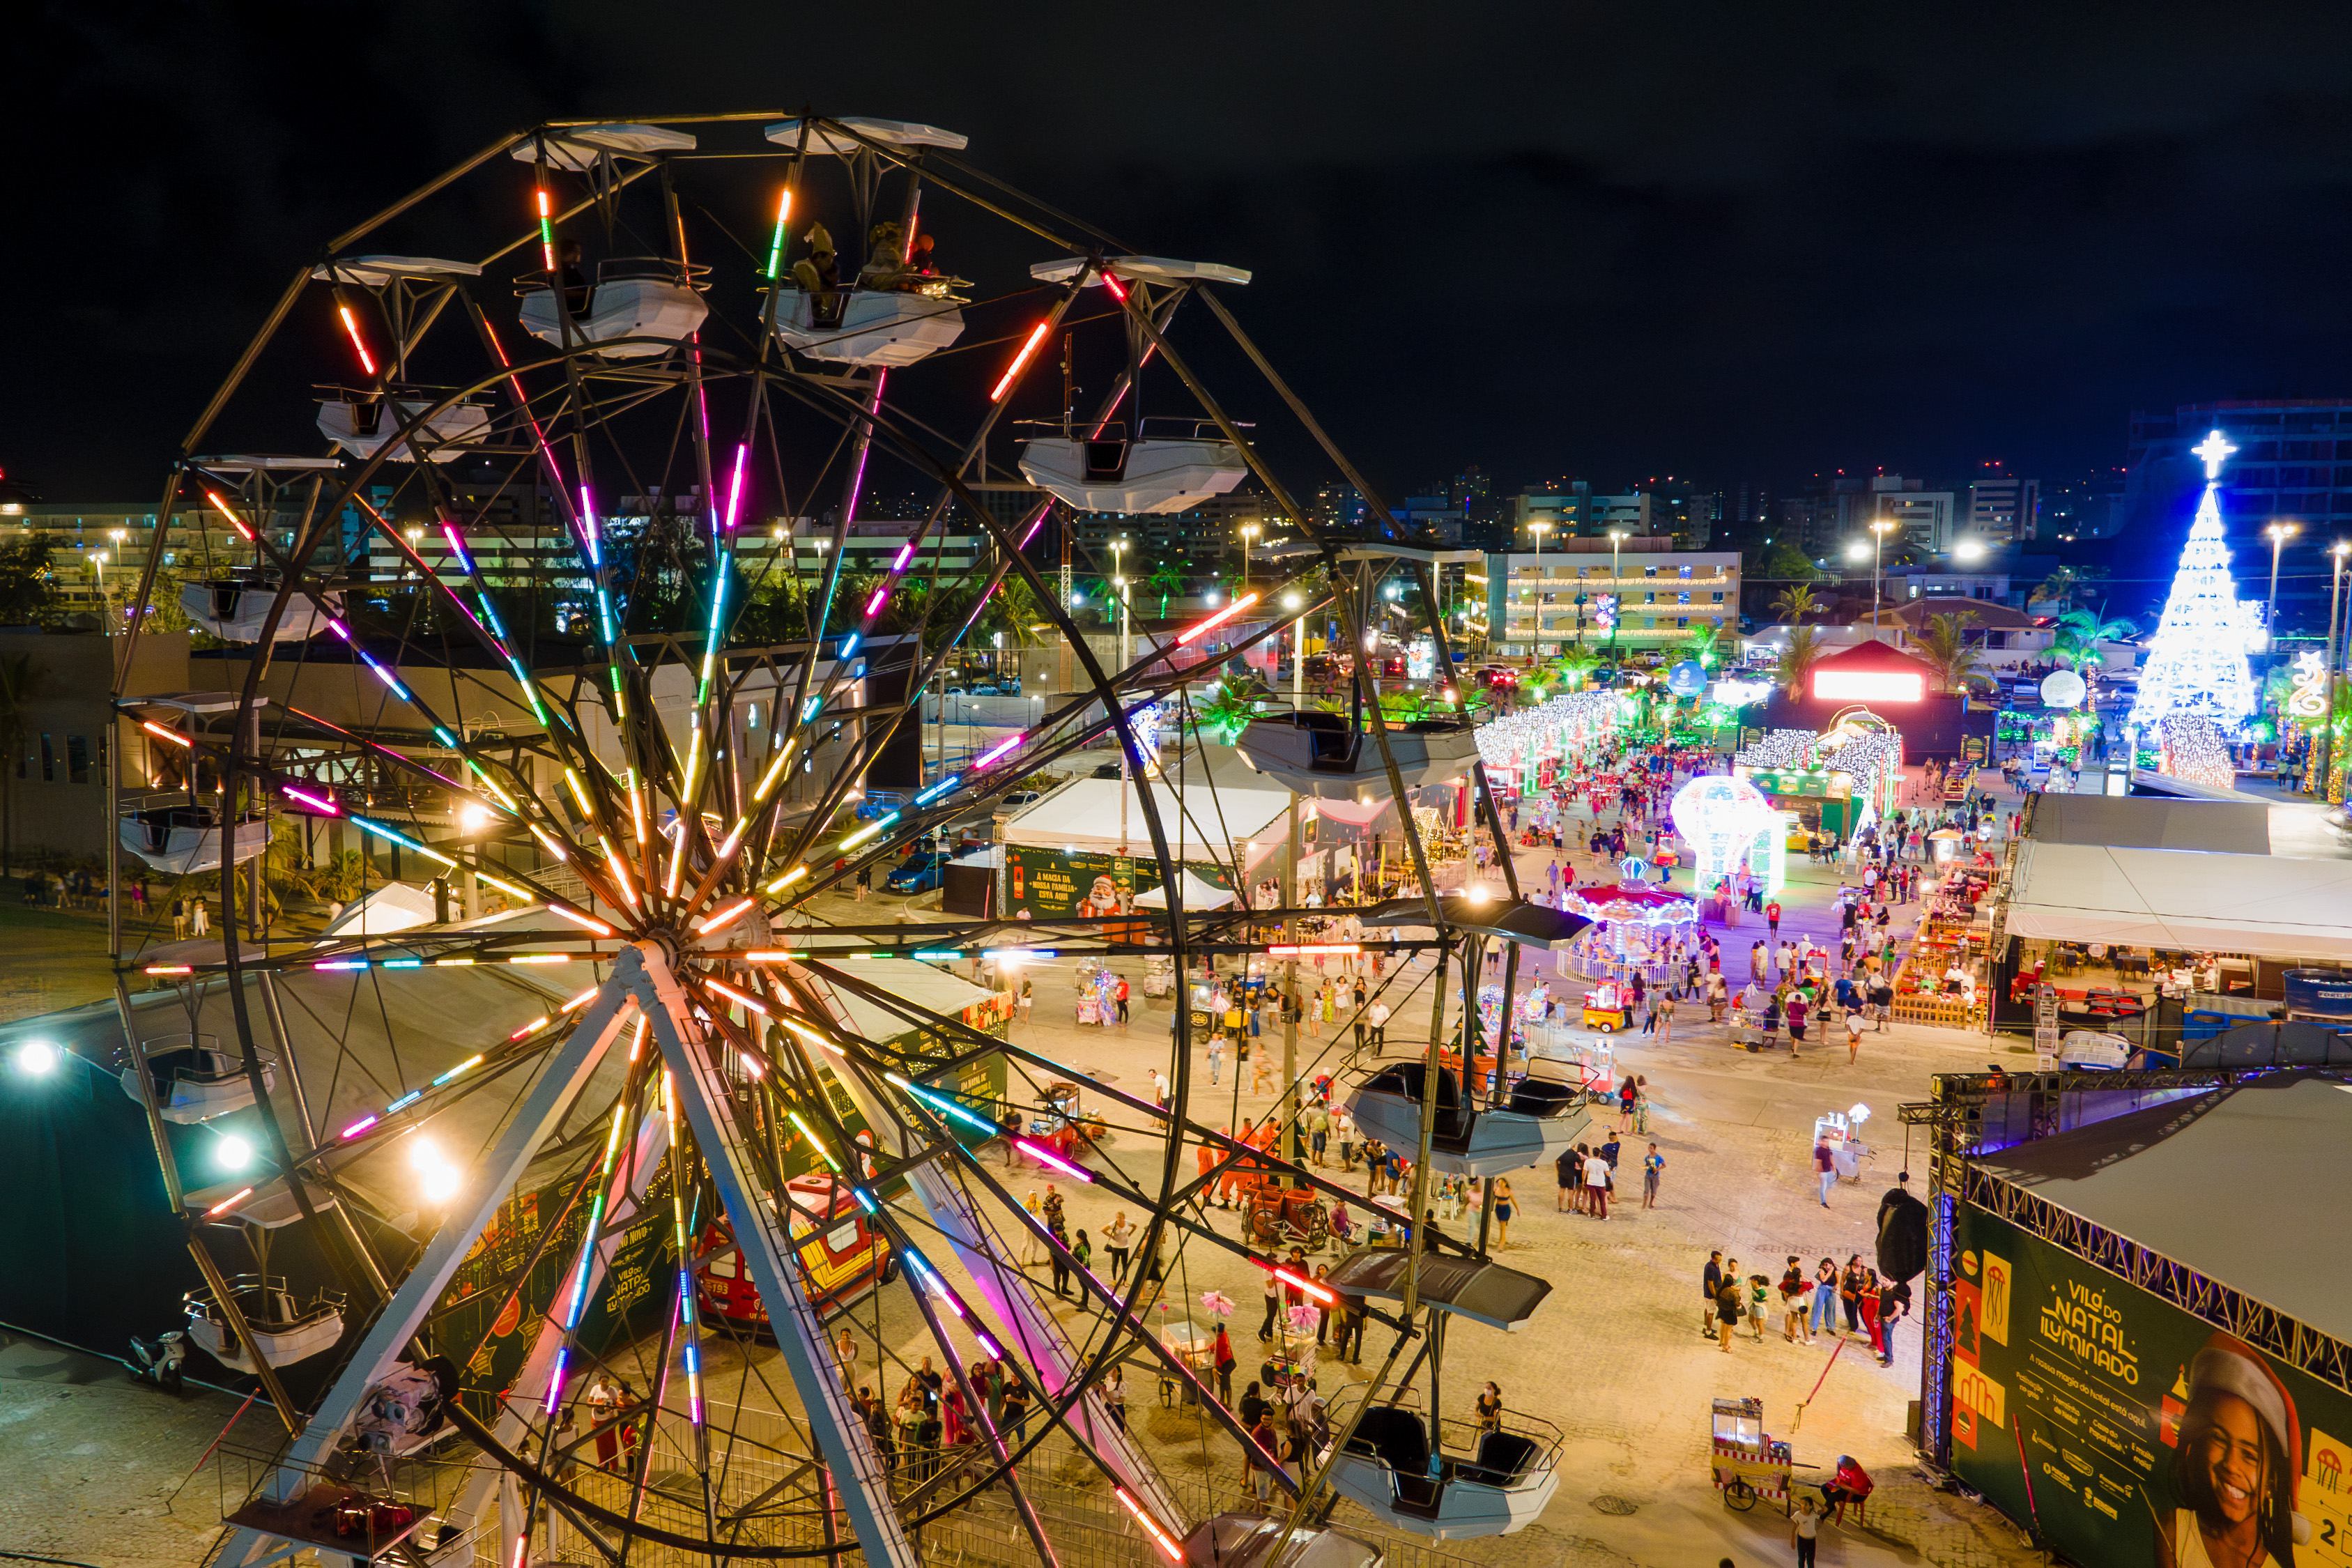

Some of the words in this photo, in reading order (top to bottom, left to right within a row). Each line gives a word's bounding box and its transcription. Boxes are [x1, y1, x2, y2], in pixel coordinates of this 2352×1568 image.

[1033, 881, 1050, 890] NOSSA
[1036, 872, 1041, 881] A
[1043, 873, 1061, 882] MAGIA
[1062, 875, 1070, 884] DA
[629, 1226, 648, 1245] NOVO
[633, 1266, 642, 1275] DO
[712, 1284, 729, 1295] 193
[2103, 1305, 2121, 1323] DO
[2042, 1296, 2137, 1363] NATAL
[2040, 1315, 2139, 1385] ILUMINADO
[2029, 1353, 2035, 1362] A
[2036, 1358, 2056, 1374] nossa
[2056, 1369, 2079, 1388] magia
[2080, 1383, 2089, 1394] do
[2090, 1388, 2110, 1407] Natal
[2110, 1402, 2127, 1417] está
[2061, 1410, 2079, 1425] Natal
[2320, 1518, 2335, 1547] 2
